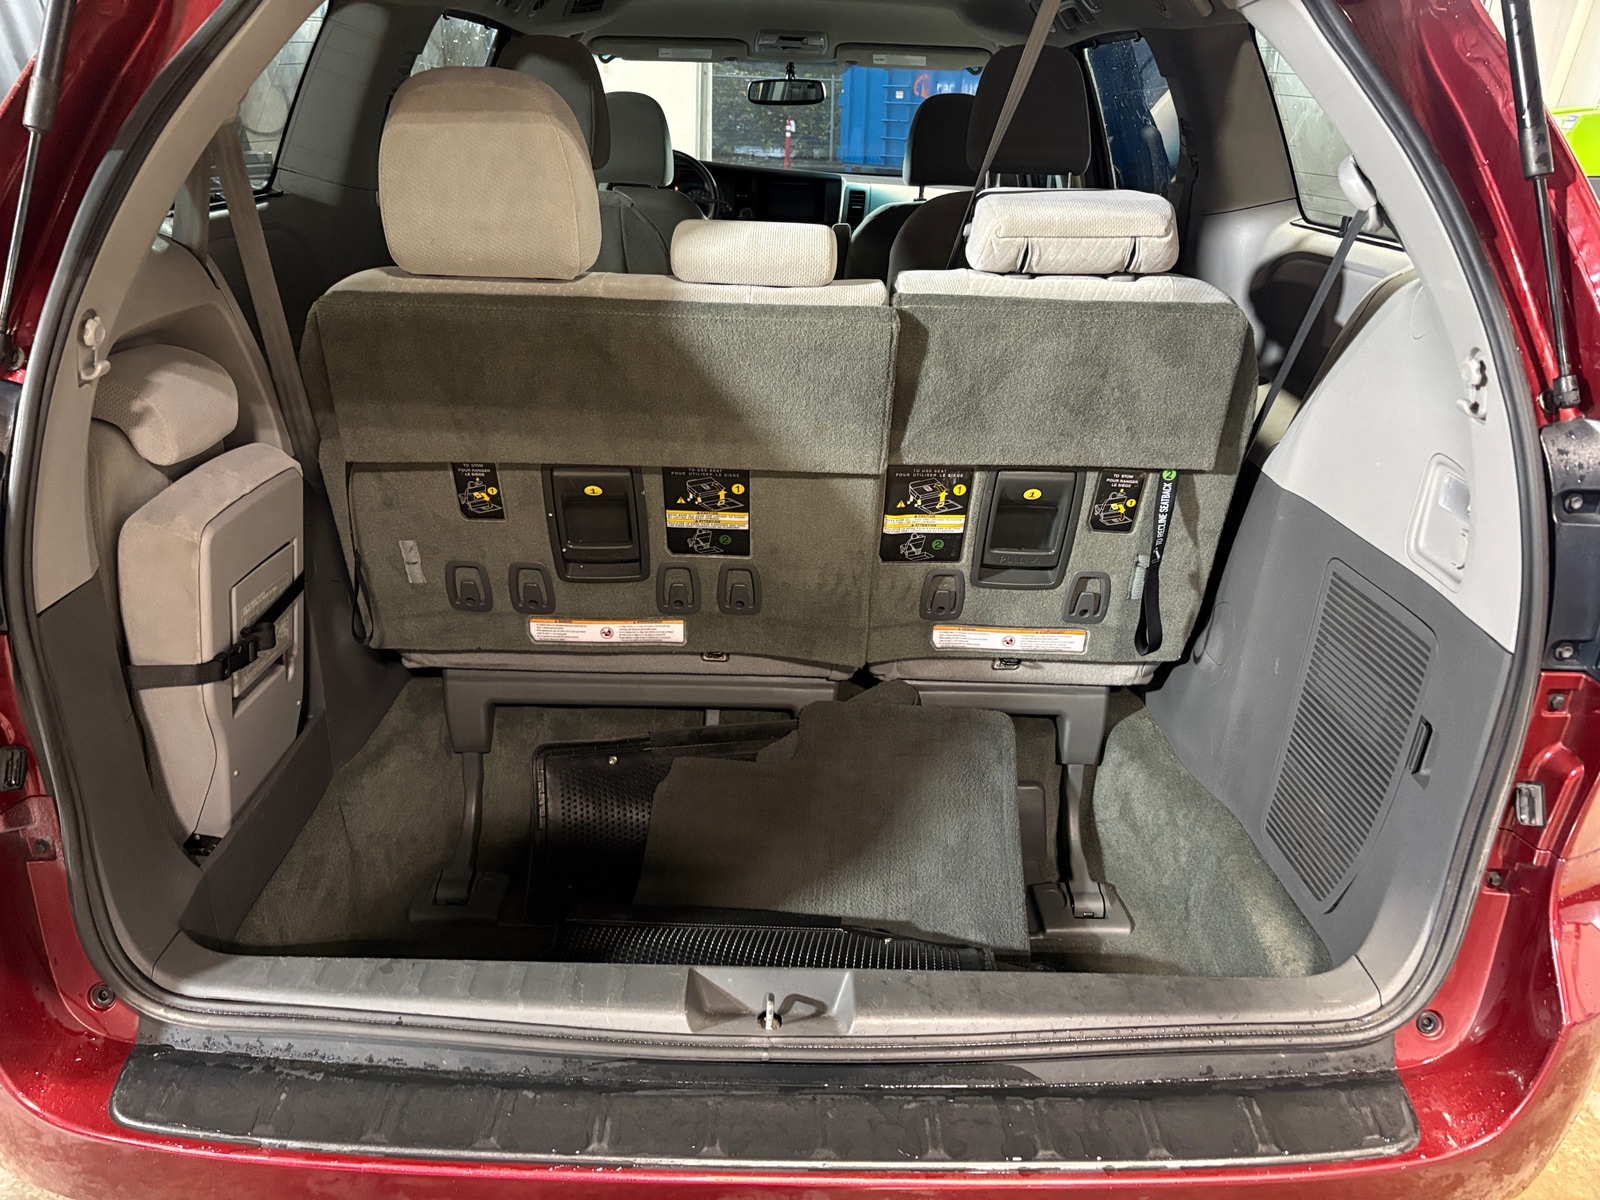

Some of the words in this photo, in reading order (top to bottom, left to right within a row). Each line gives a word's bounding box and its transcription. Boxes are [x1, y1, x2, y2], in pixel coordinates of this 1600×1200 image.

[1159, 482, 1173, 513] SEATBACK
[1157, 513, 1168, 538] RECLINE
[1155, 538, 1163, 546] TO
[1000, 556, 1025, 564] PULL
